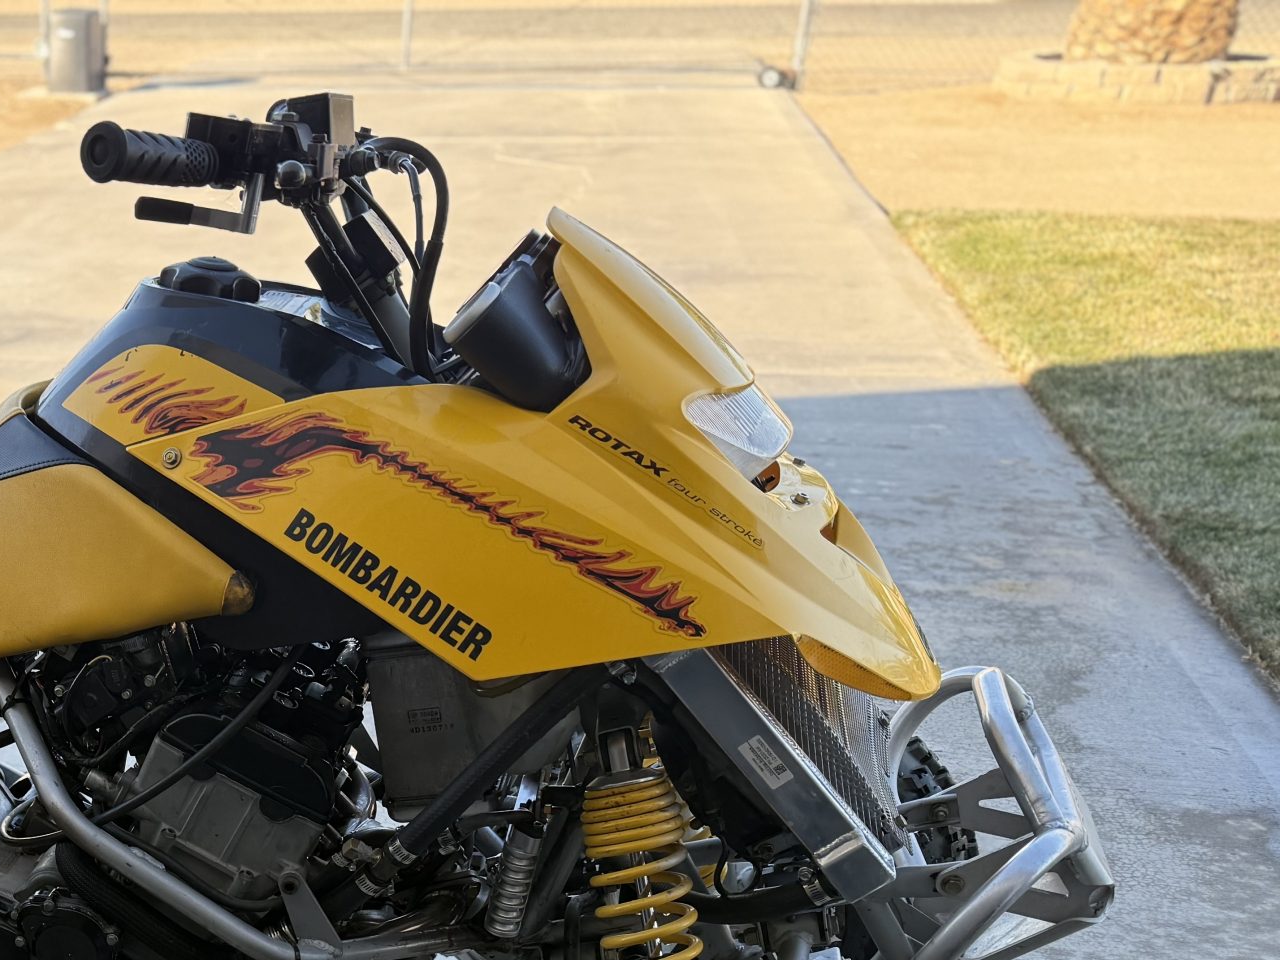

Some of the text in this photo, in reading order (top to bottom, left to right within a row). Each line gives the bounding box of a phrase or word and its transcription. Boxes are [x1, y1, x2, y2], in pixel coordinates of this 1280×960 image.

[568, 415, 766, 547] ROTAX four stroke
[283, 507, 493, 662] BOMBARDIER
